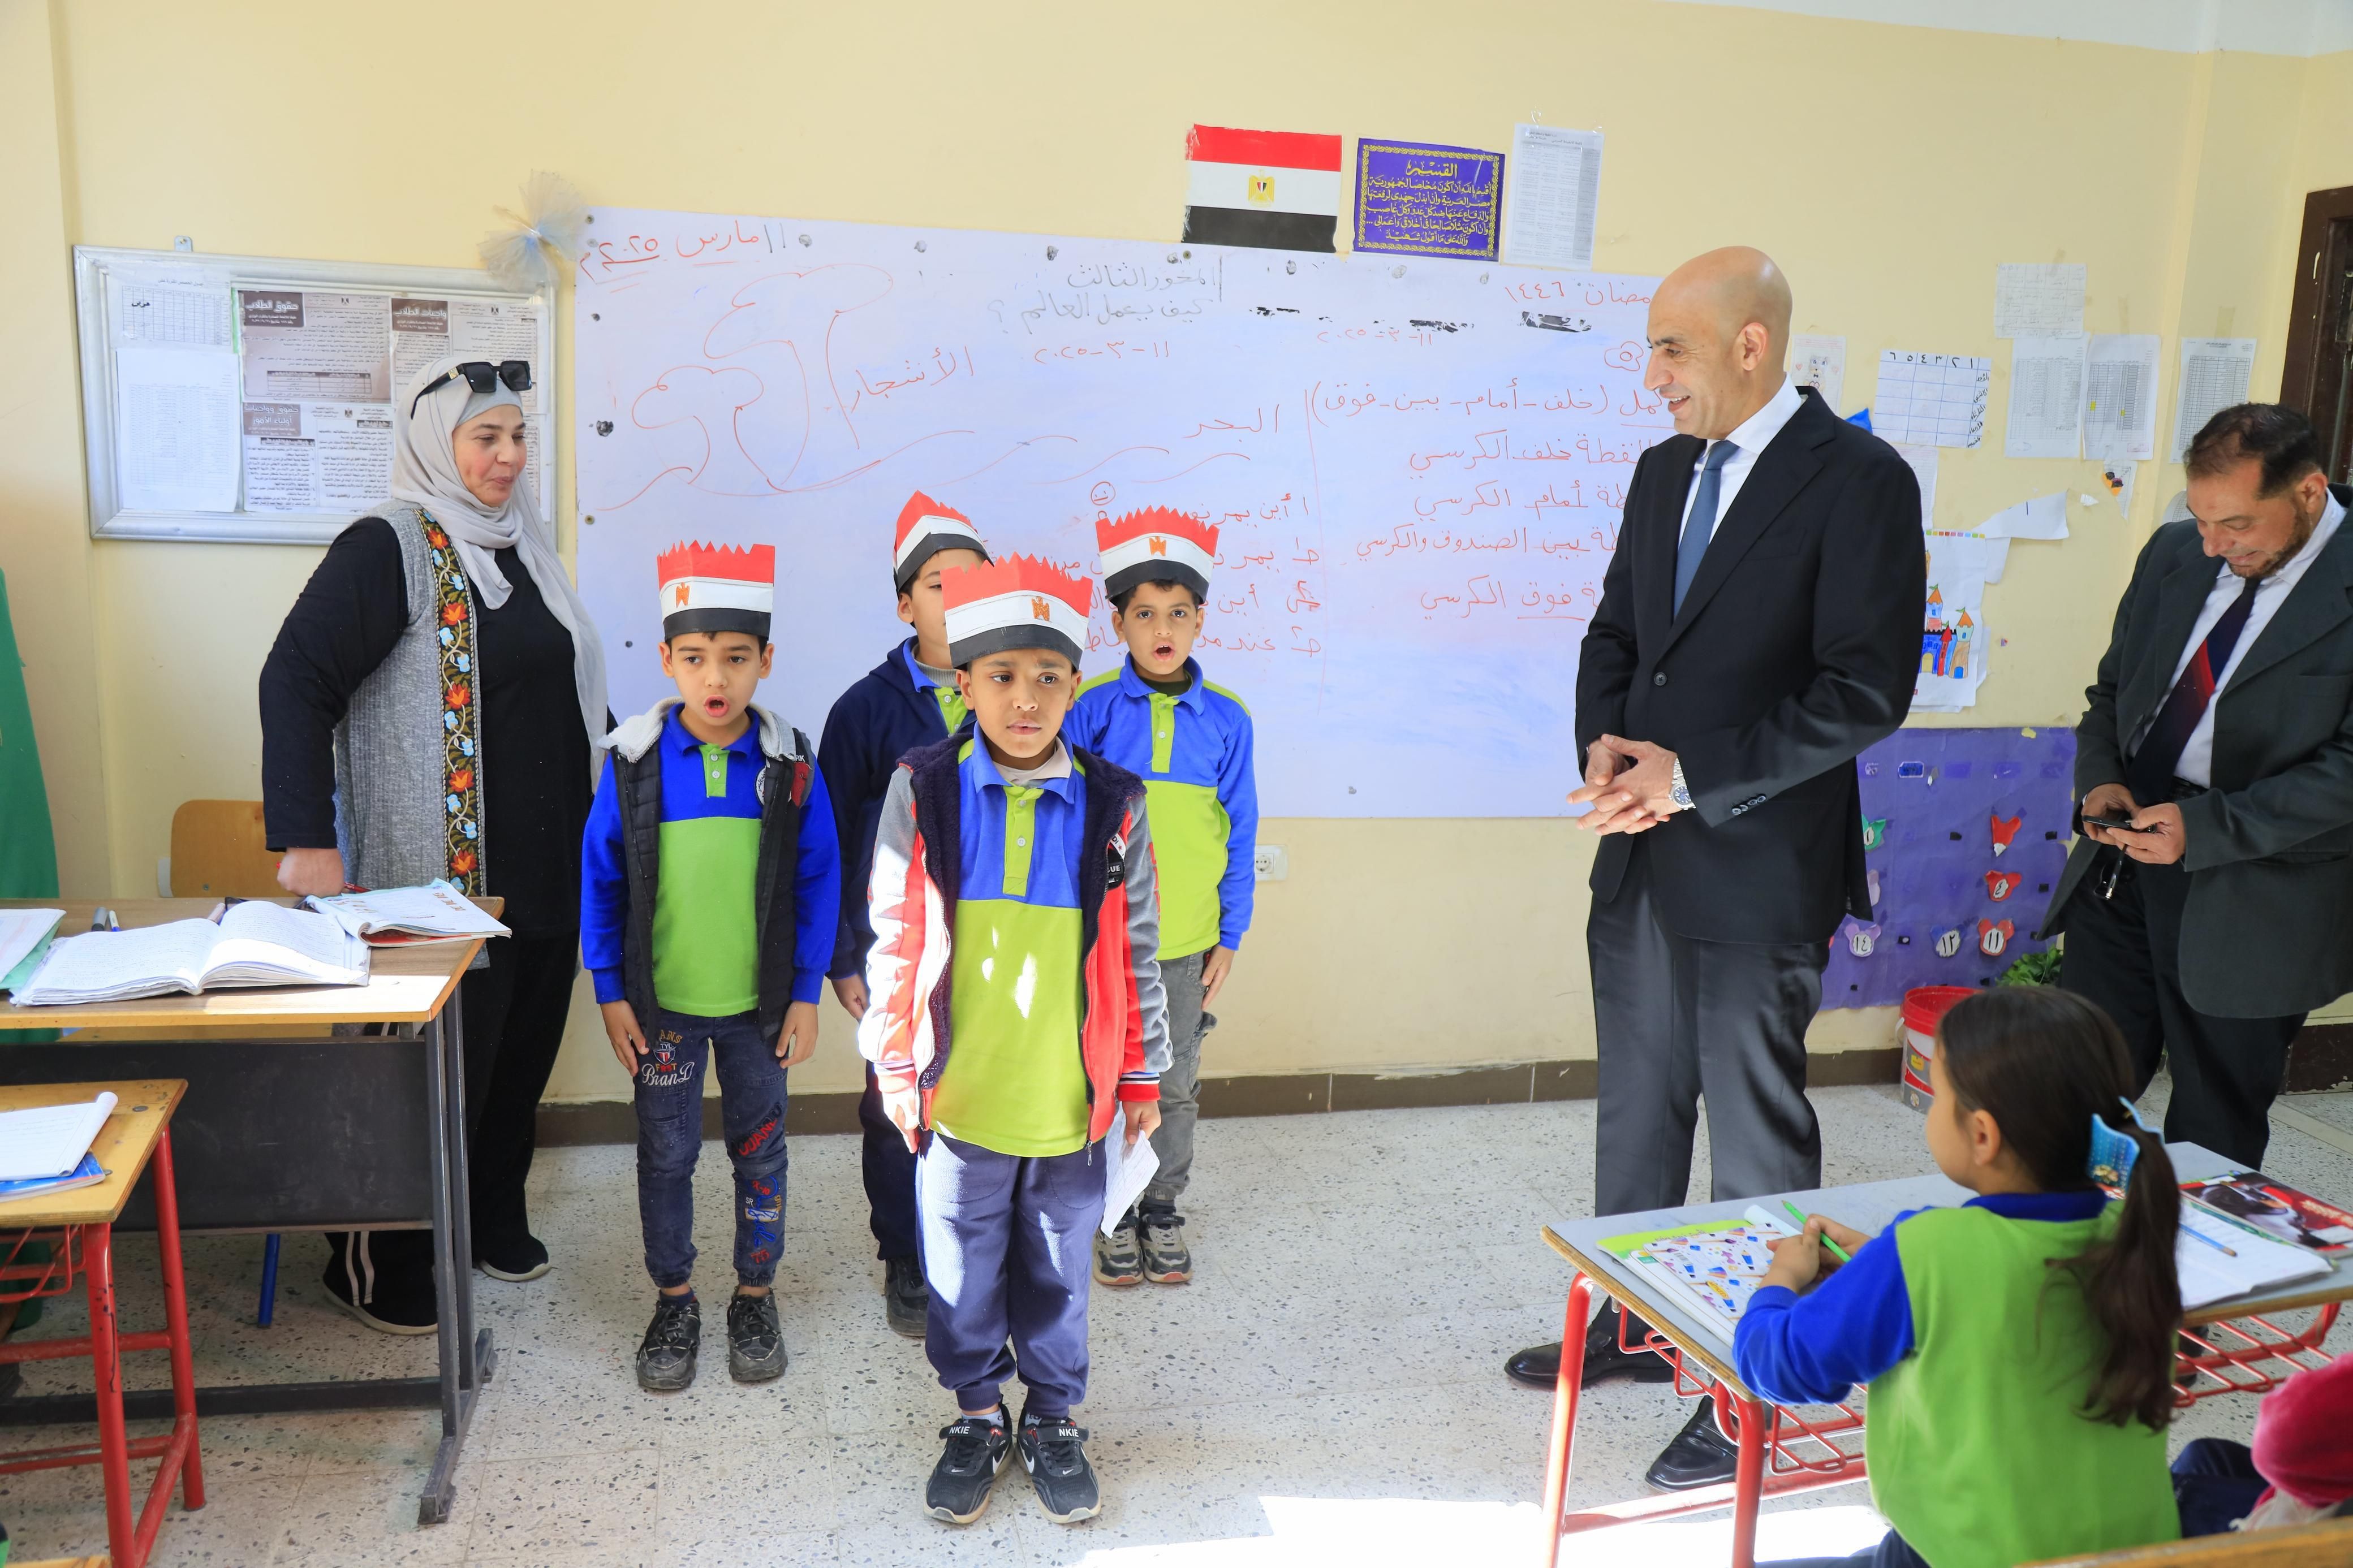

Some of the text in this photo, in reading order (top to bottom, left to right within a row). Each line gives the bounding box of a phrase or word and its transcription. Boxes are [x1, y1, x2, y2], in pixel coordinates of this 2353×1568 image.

[676, 219, 759, 257] مارس
[1067, 262, 1146, 288] الثالث
[244, 299, 273, 312] الطلاب
[1586, 282, 1651, 306] مضان
[1020, 290, 1089, 335] العالم
[1097, 293, 1154, 325] يعمل
[1161, 299, 1213, 322] كيف
[949, 1426, 971, 1435] NKIE
[1058, 1428, 1079, 1438] NKIE
